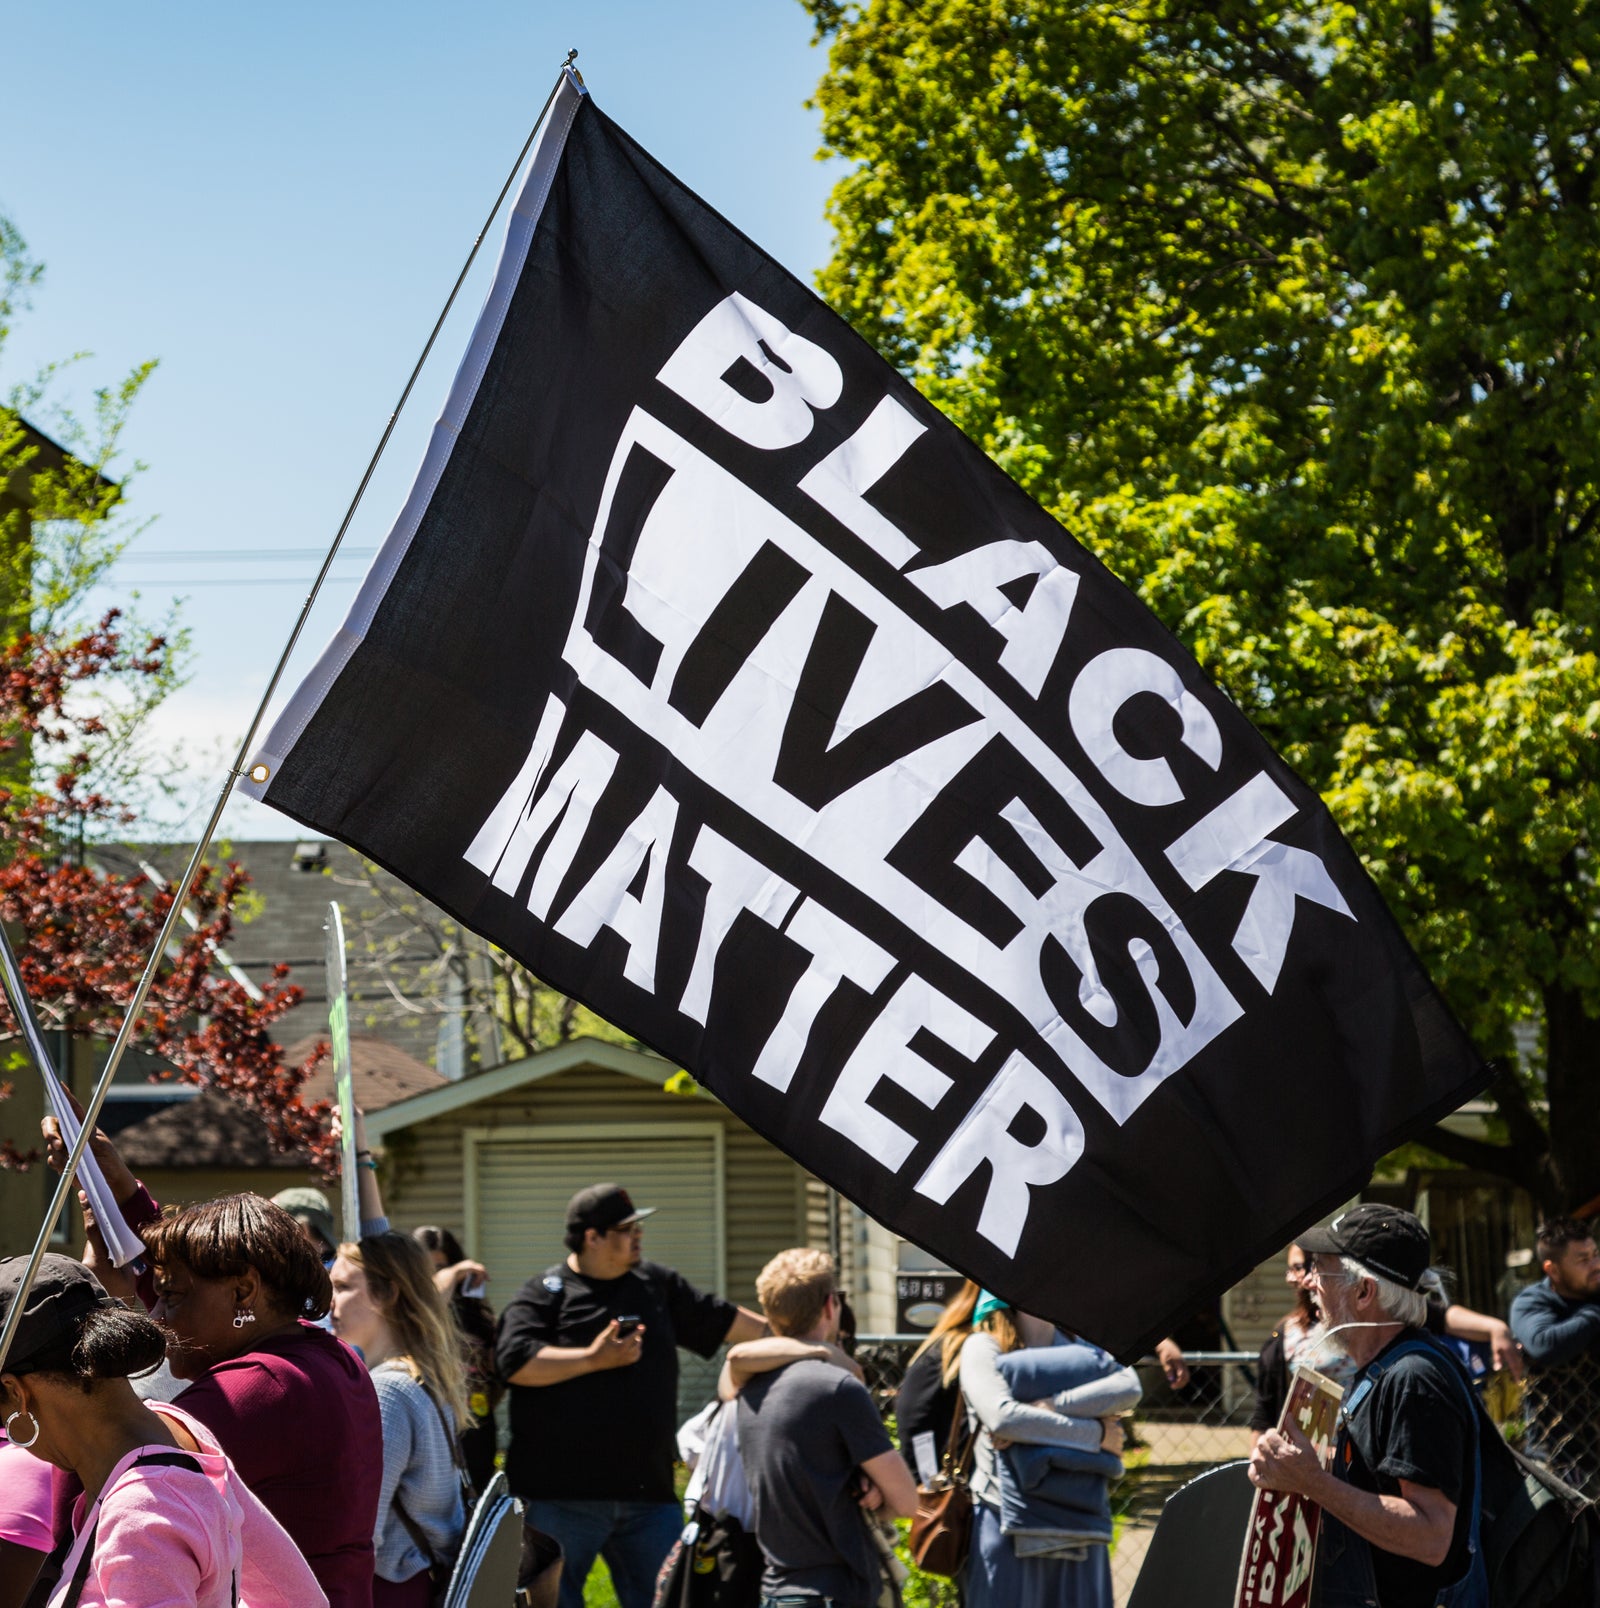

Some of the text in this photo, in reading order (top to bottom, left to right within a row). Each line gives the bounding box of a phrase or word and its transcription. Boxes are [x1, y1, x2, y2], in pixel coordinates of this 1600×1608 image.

[583, 440, 1199, 1078] LIVES
[656, 290, 1358, 996] BLACK
[462, 692, 1086, 1259] MATTER
